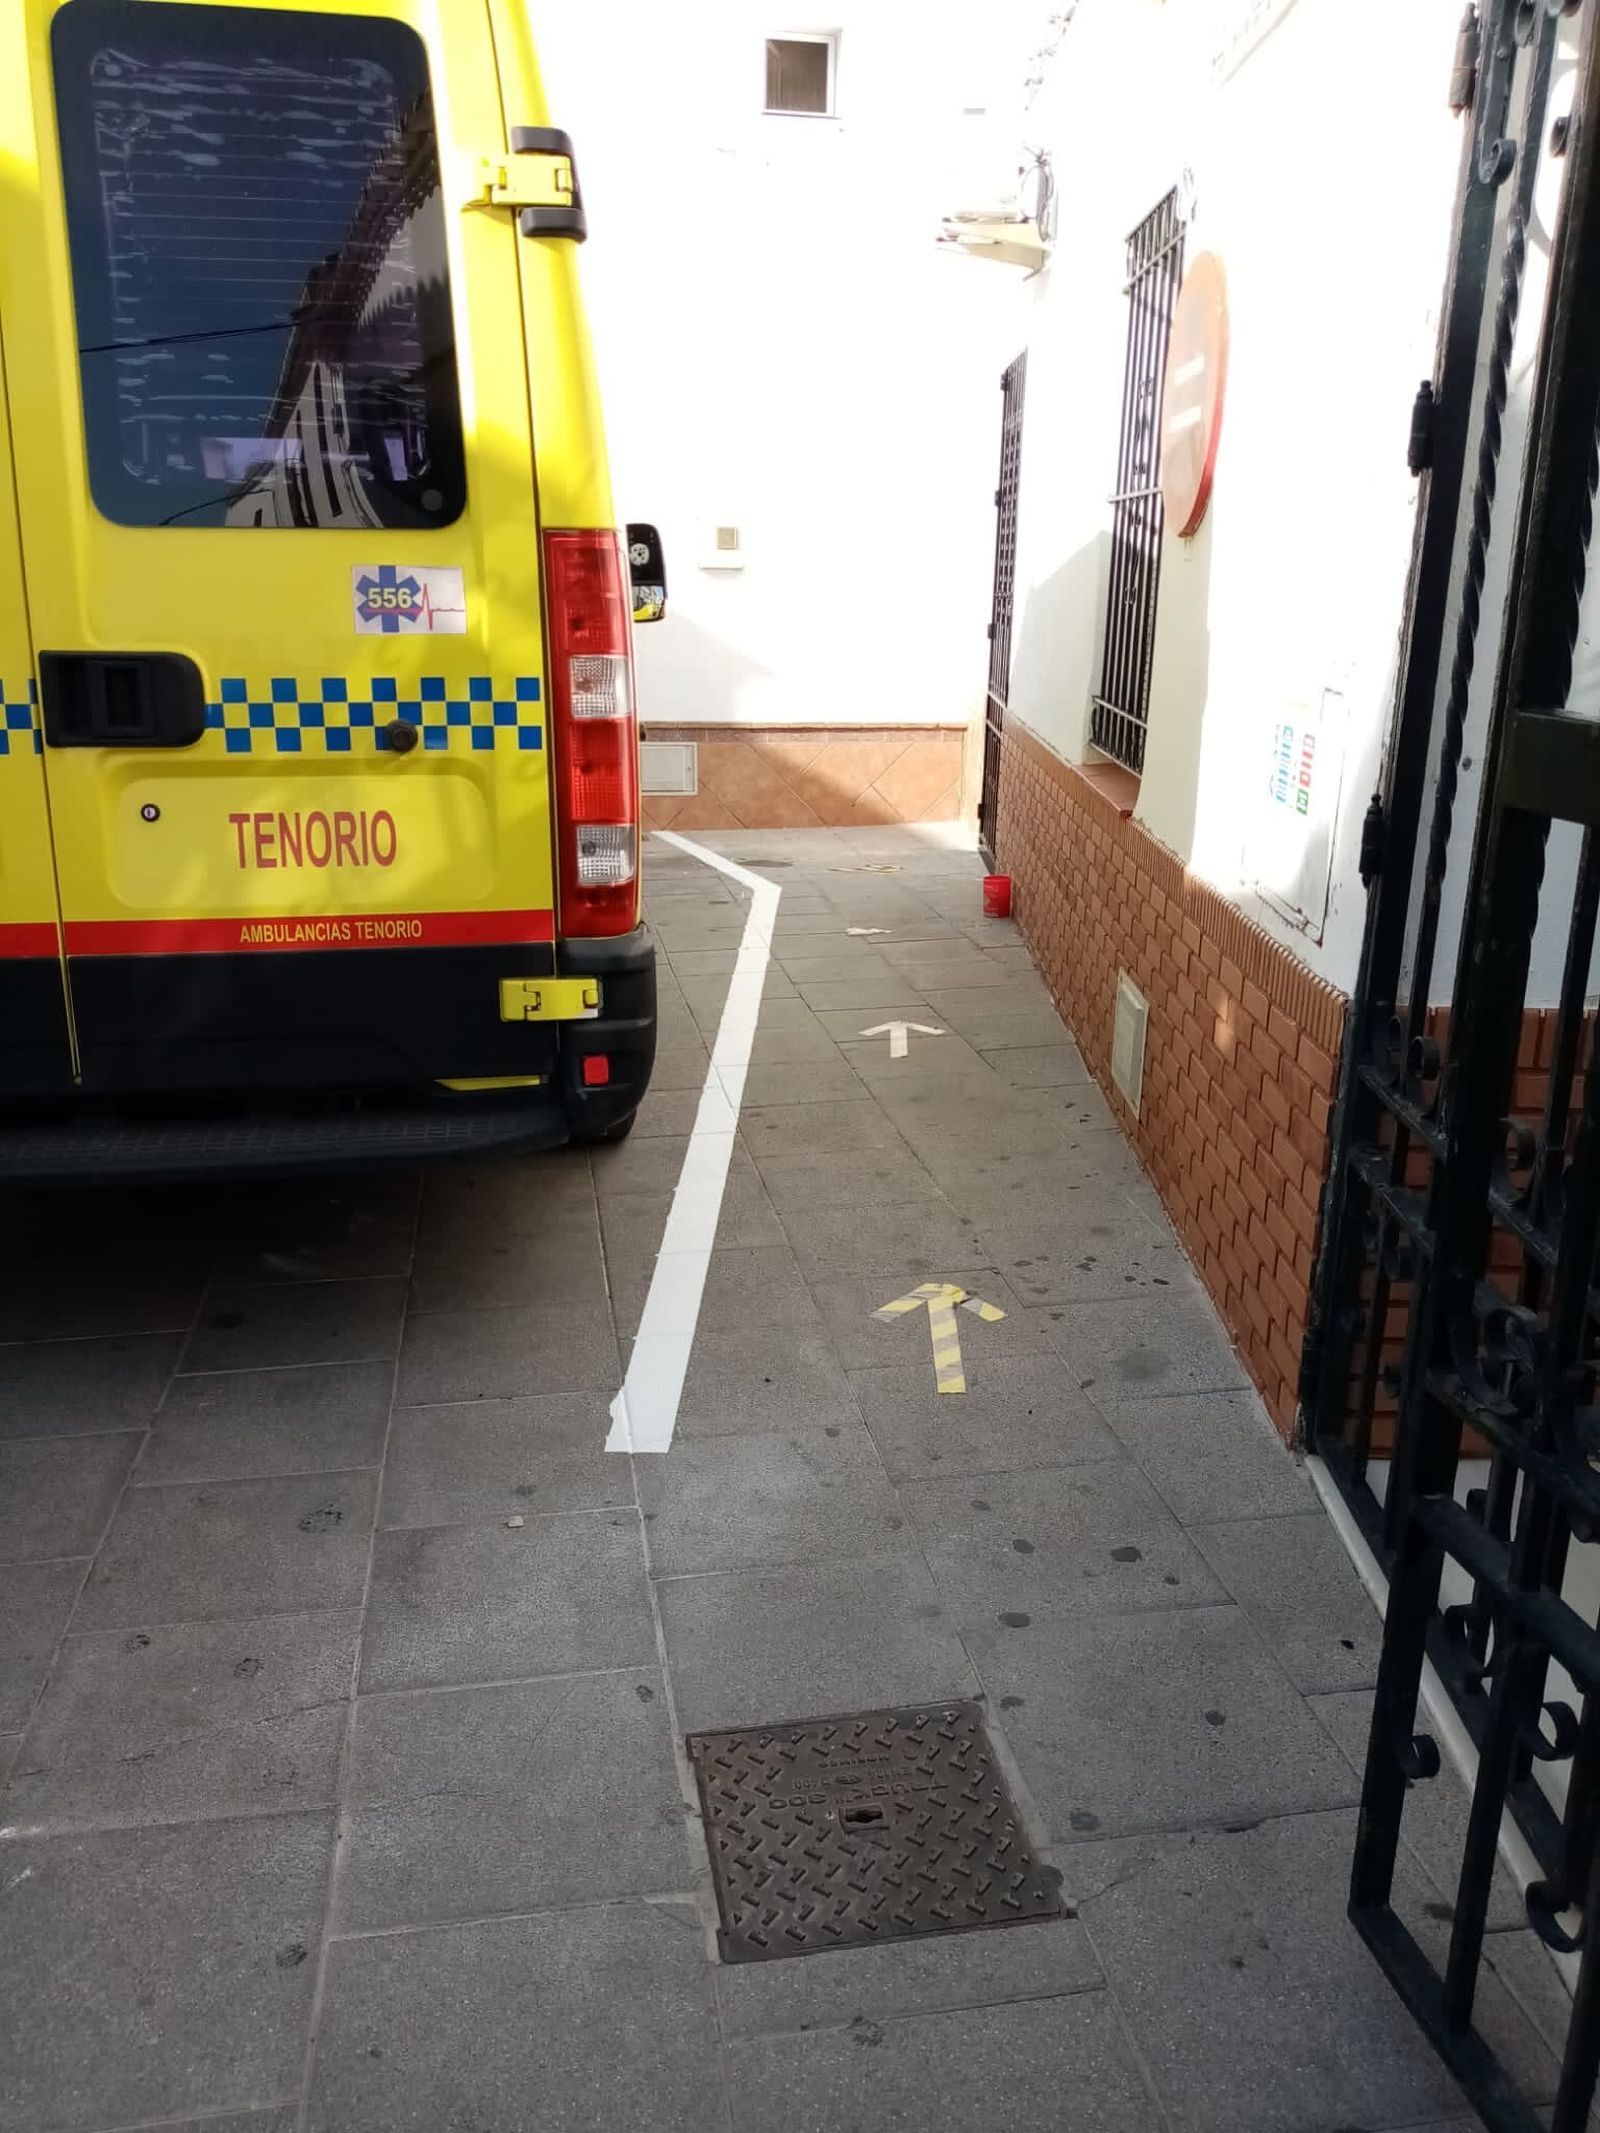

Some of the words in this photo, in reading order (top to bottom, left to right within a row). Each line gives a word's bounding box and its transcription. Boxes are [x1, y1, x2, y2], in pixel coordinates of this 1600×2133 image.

[367, 587, 412, 609] 556
[228, 810, 397, 869] TENORIO
[239, 922, 351, 943] AMBULANCIAS
[355, 919, 422, 939] TENORIO
